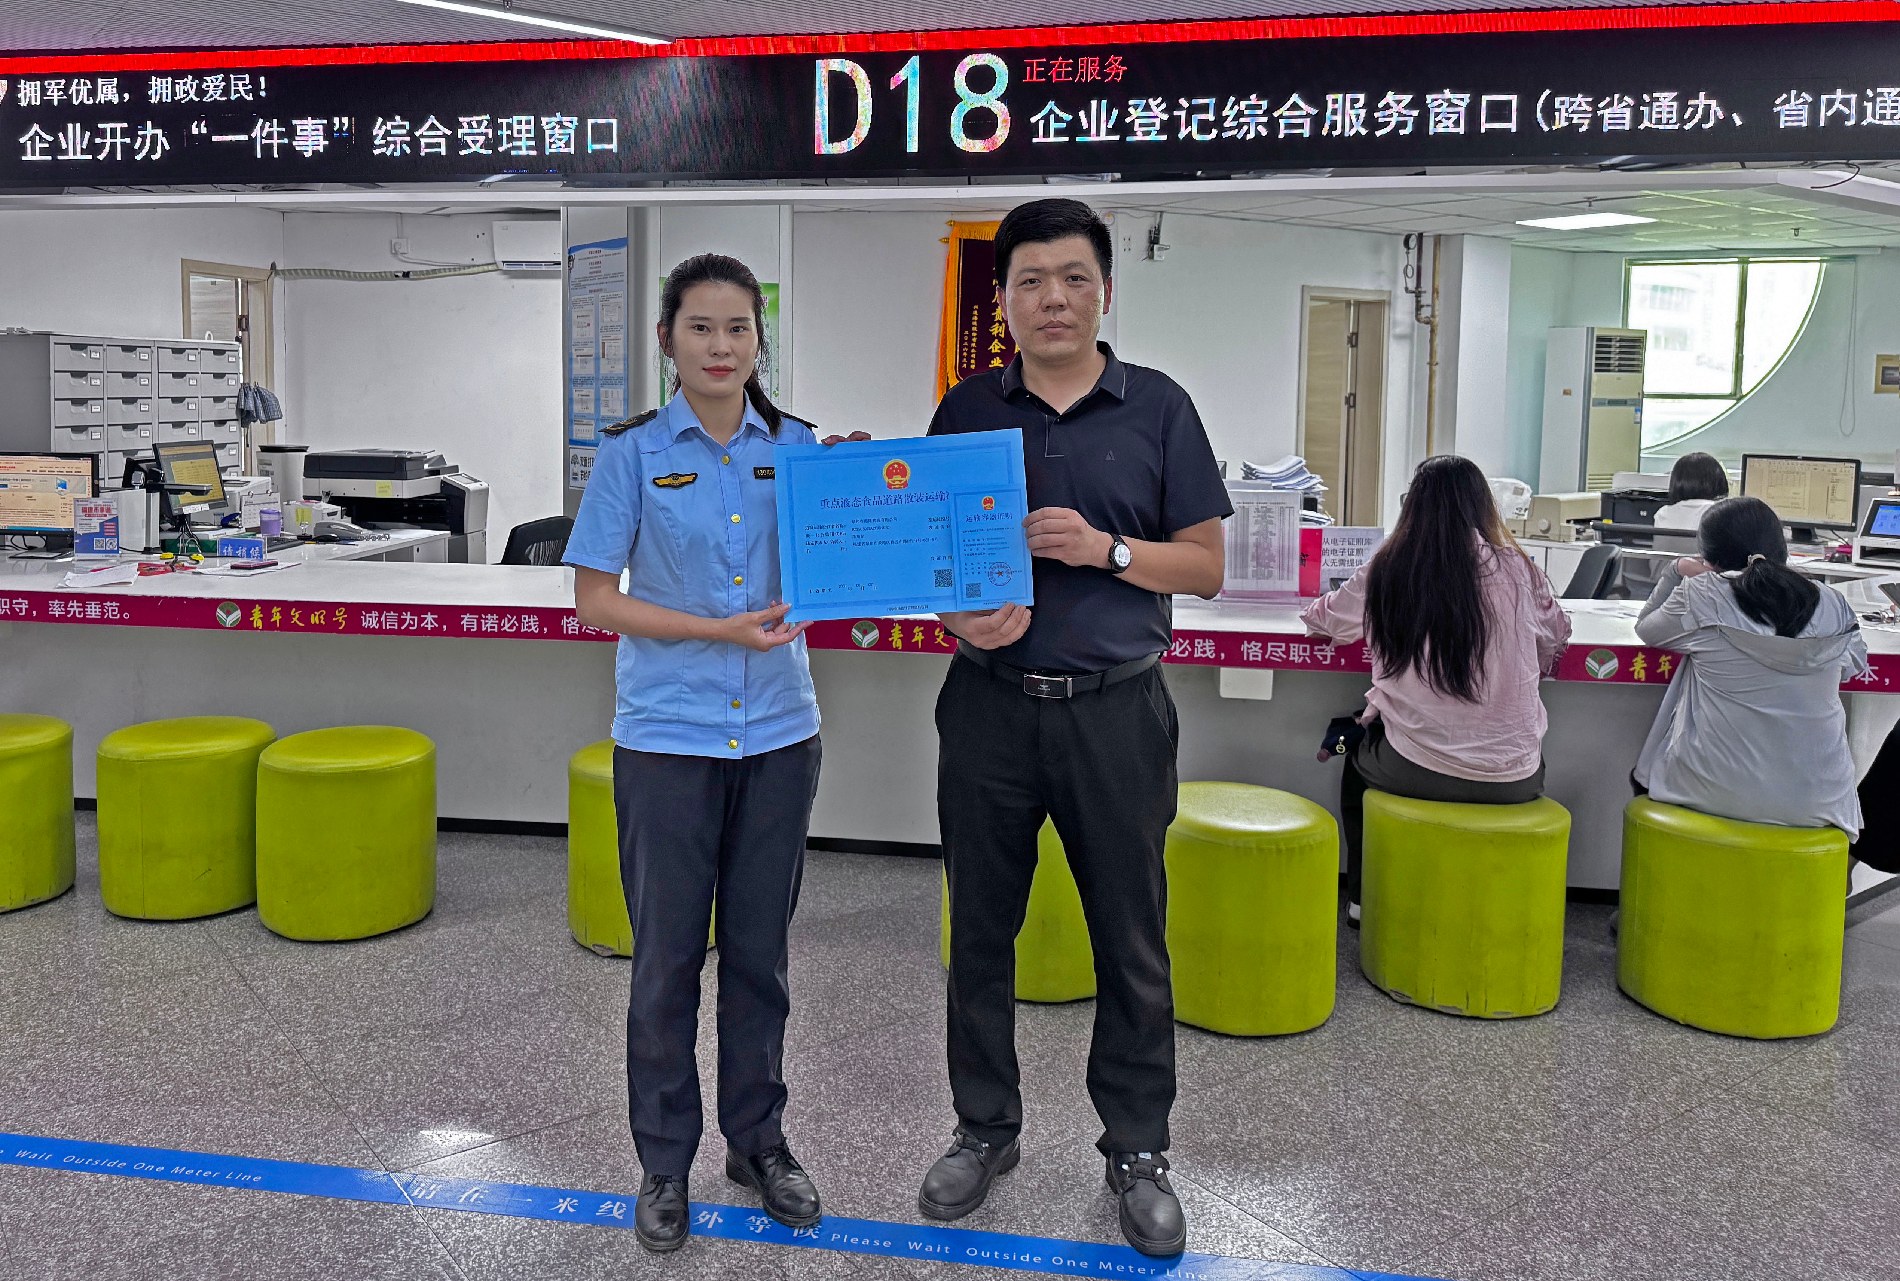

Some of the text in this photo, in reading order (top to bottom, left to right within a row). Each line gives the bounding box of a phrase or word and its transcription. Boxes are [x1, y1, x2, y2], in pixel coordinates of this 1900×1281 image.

[1022, 54, 1128, 84] 正在服务
[16, 73, 268, 107] 拥军优属，拥政爱民！
[814, 52, 1011, 155] D18
[820, 490, 950, 510] 重点液态食品道路散装运输
[1159, 637, 1374, 666] 必践，恪尽职守，
[1628, 654, 1673, 682] 青年
[15, 1149, 53, 1161] Wait
[62, 1155, 127, 1170] Outside
[133, 1162, 165, 1173] One
[170, 1166, 221, 1181] Meter
[225, 1171, 263, 1183] Line
[831, 1233, 1208, 1281] Please Wait Outside One Meter Line
